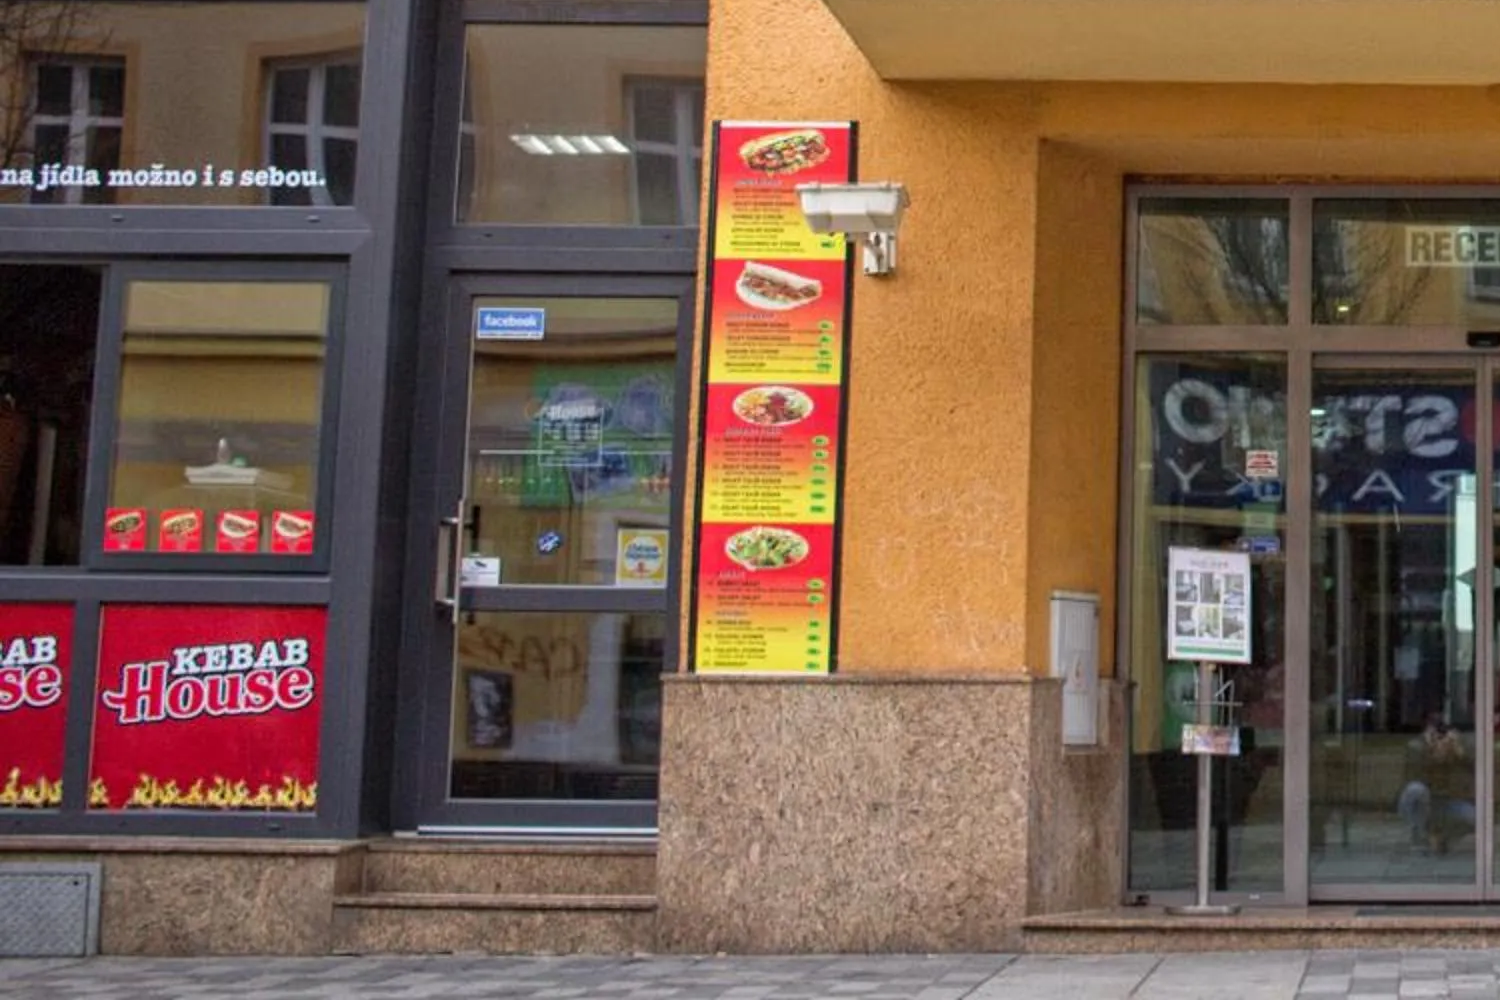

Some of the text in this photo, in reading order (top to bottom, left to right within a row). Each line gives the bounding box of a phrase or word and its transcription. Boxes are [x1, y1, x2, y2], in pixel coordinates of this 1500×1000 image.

[1, 162, 326, 191] na jídla možno i s sebou.
[483, 312, 538, 328] facebook
[171, 638, 309, 676] KEBAB
[102, 666, 314, 725] House
